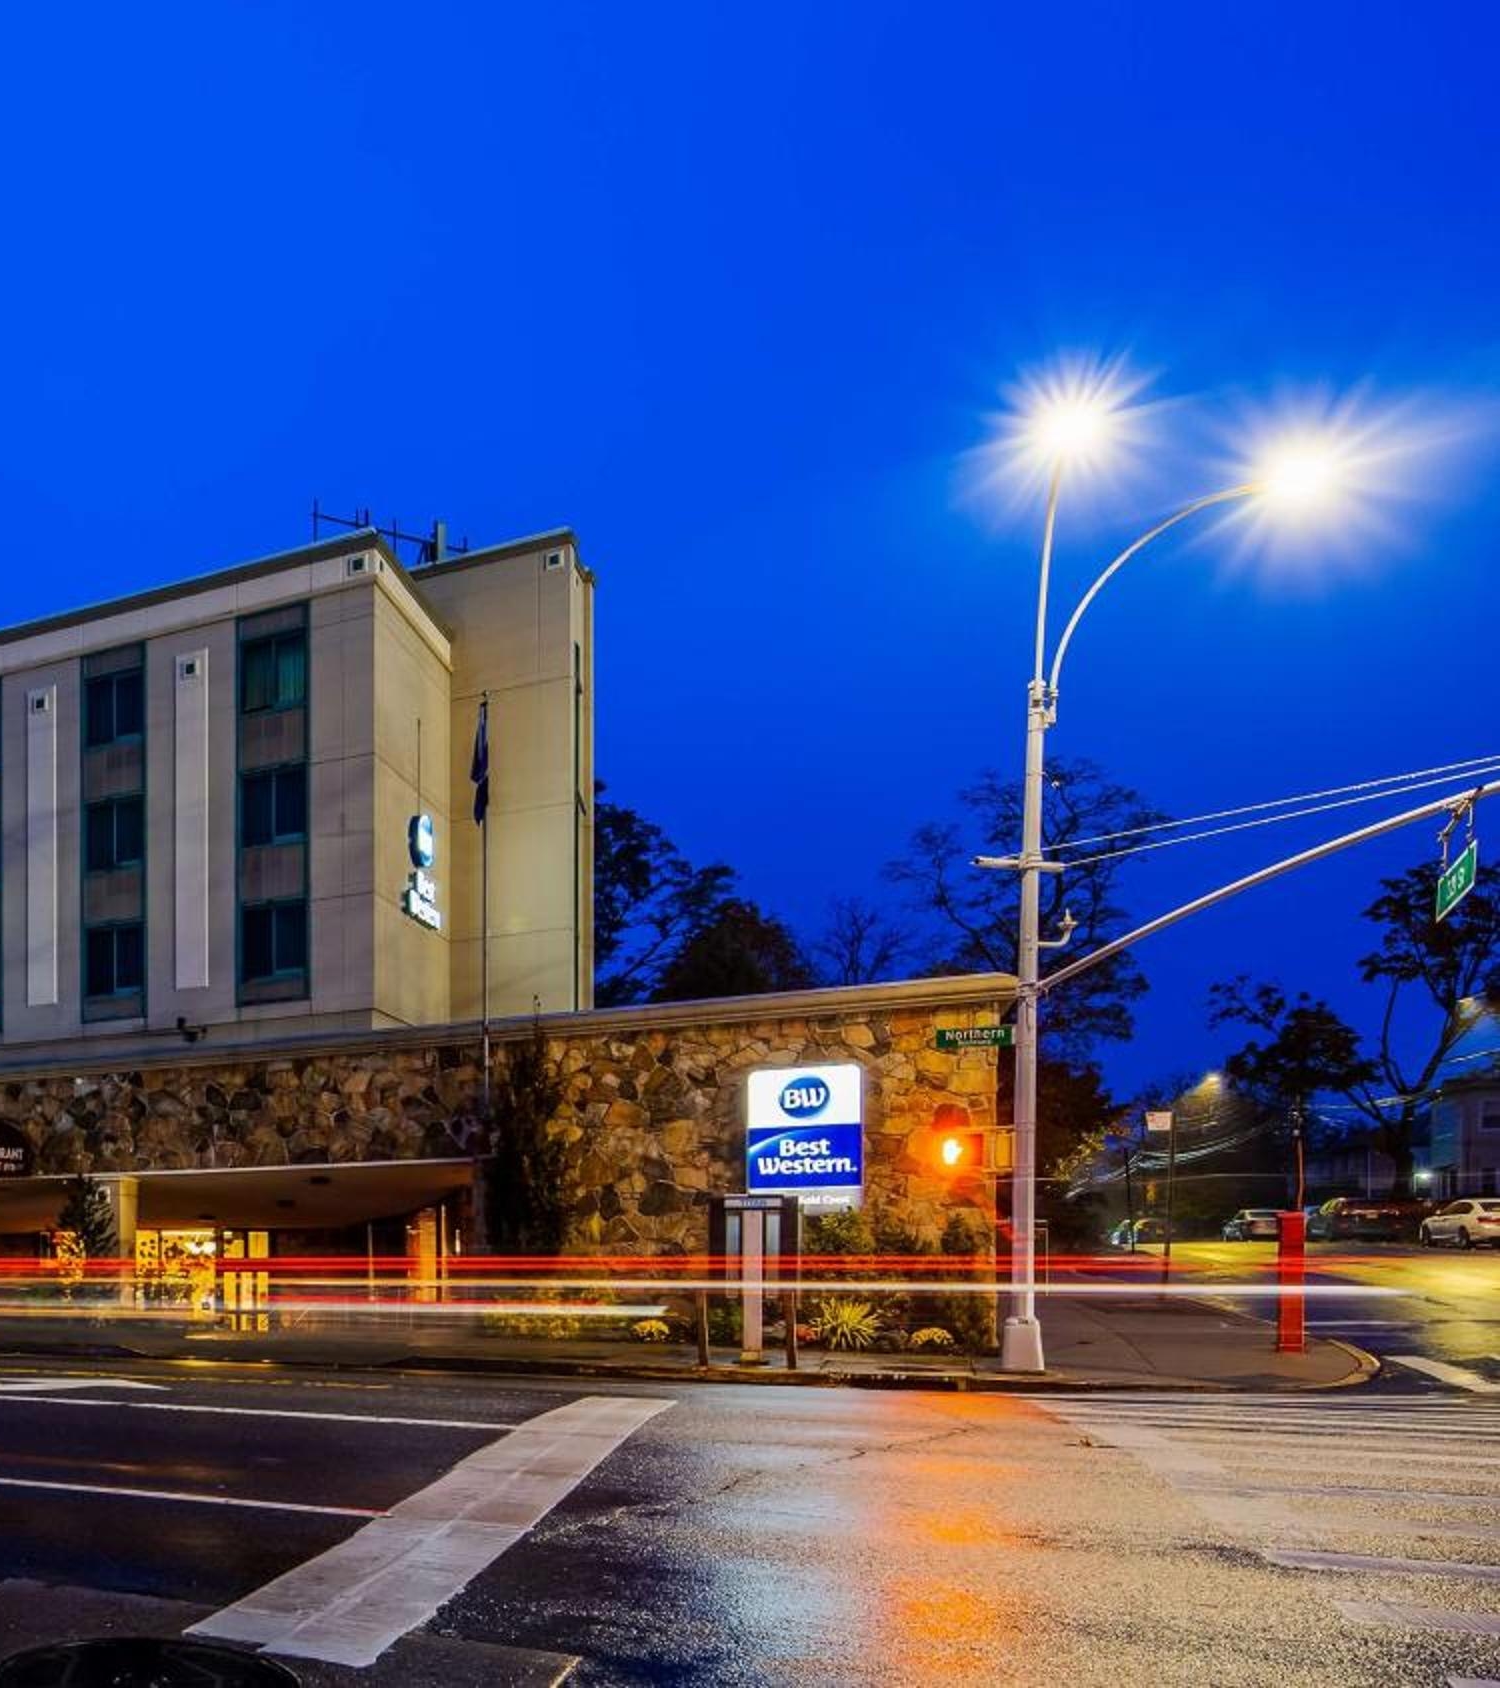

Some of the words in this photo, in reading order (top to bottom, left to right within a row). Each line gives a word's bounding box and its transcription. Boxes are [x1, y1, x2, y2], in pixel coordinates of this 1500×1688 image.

[944, 1029, 1005, 1041] Northern
[783, 1087, 826, 1109] BW
[779, 1138, 831, 1157] Best
